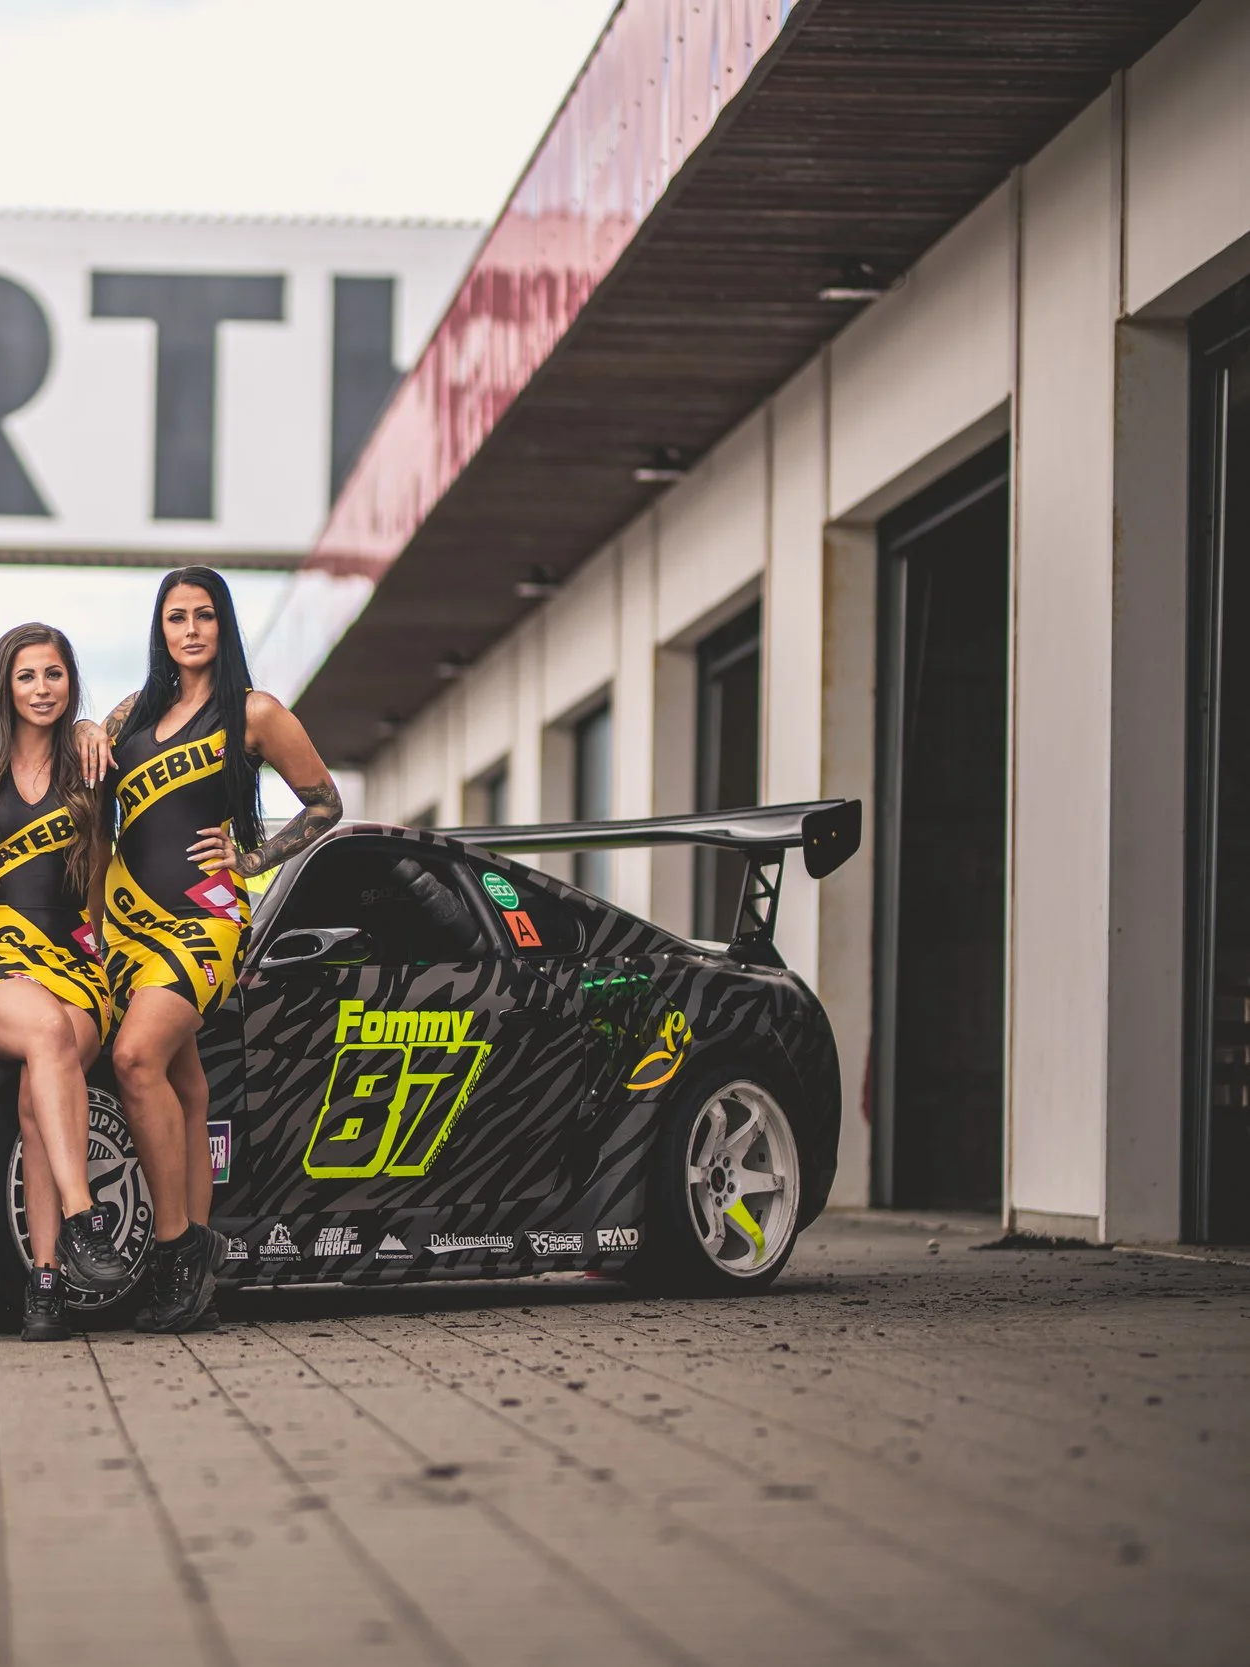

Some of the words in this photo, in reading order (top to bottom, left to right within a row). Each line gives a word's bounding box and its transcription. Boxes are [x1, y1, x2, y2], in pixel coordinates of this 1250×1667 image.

[516, 916, 535, 941] A
[334, 1000, 474, 1053] Fommy
[302, 1041, 492, 1179] 87
[89, 1111, 134, 1152] UPPLY
[430, 1232, 513, 1249] Dekkomsetning
[549, 1243, 582, 1251] SUPPLY
[597, 1226, 638, 1246] RAD
[259, 1245, 300, 1254] BJØRKESTØL
